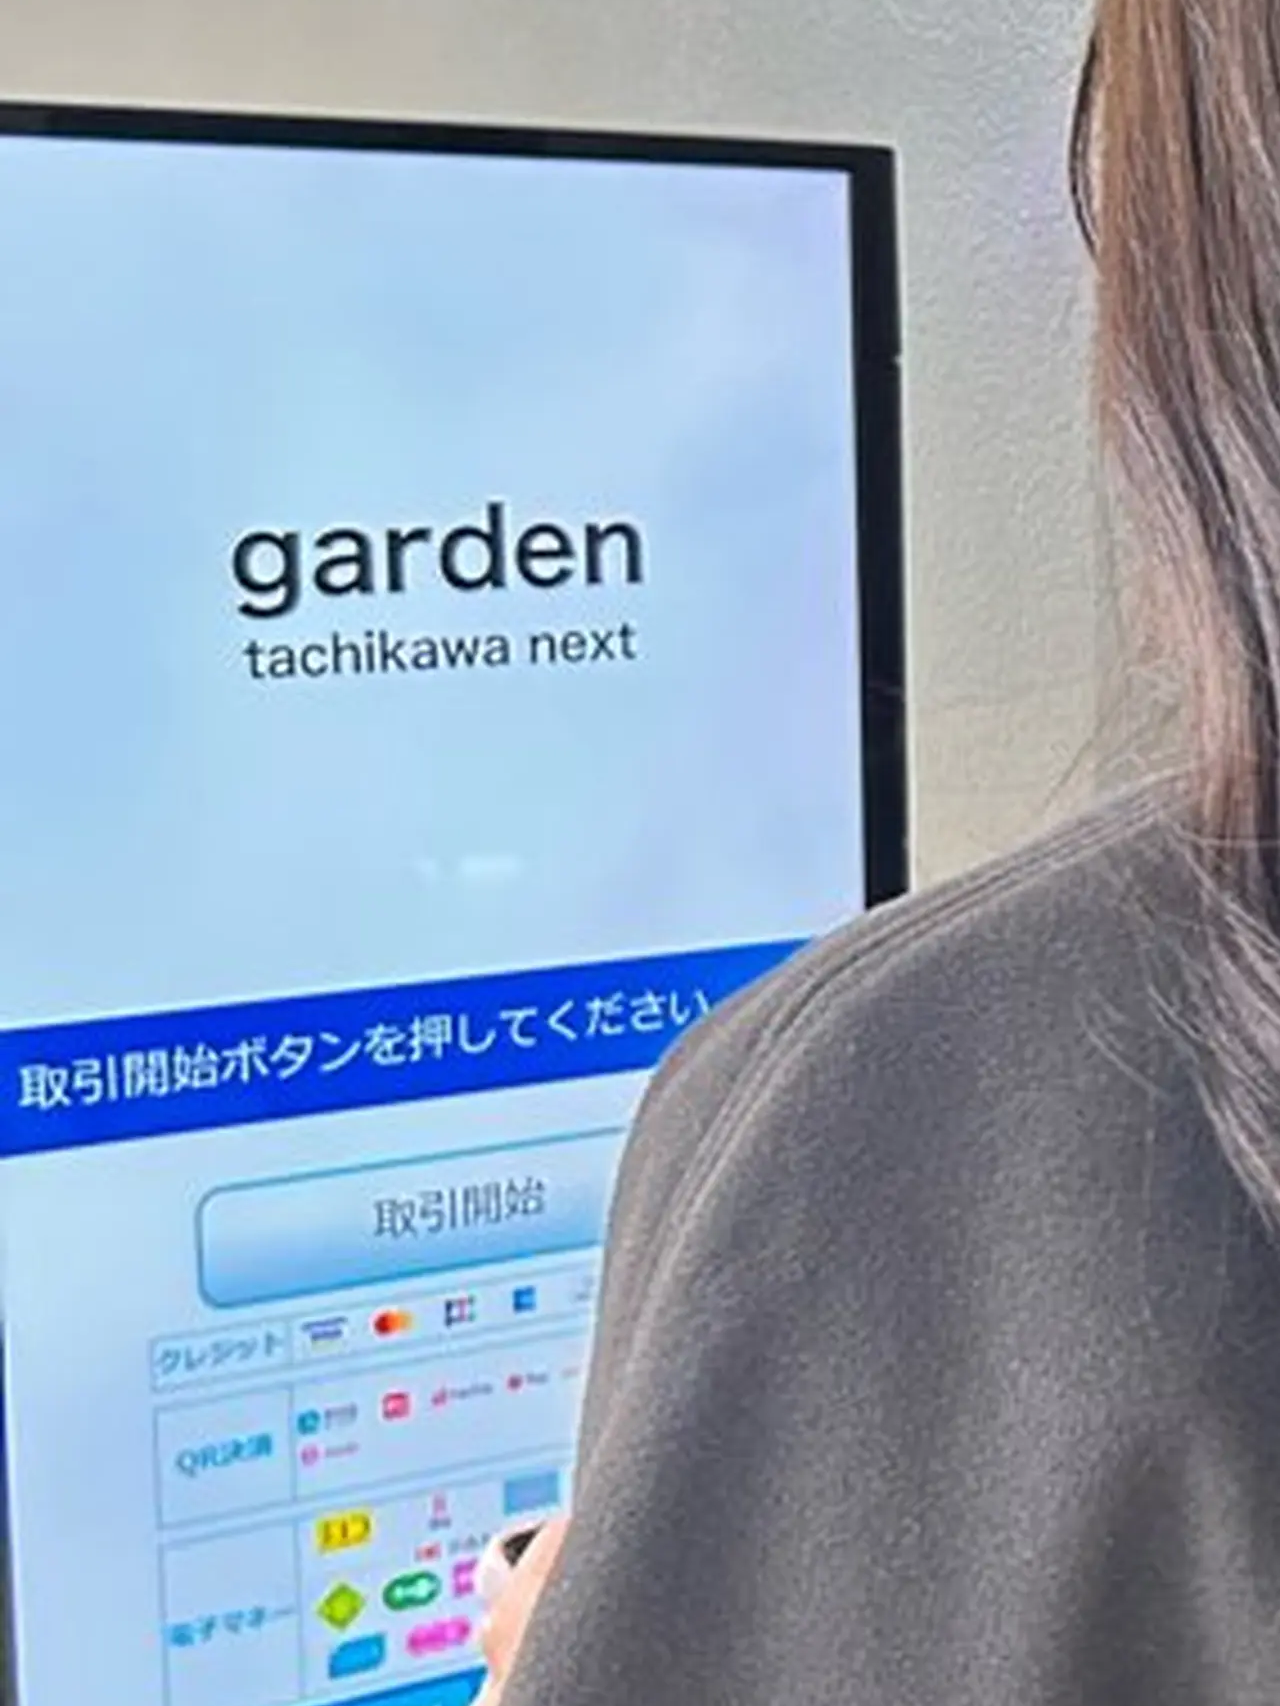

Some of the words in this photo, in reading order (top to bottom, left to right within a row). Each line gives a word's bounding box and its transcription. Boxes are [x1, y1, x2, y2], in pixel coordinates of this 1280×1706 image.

[232, 501, 644, 619] garden
[244, 629, 510, 679] tachikawa
[530, 622, 637, 665] next
[18, 989, 714, 1110] 取引開始ボタンを押してください
[373, 1176, 546, 1239] 取引開始
